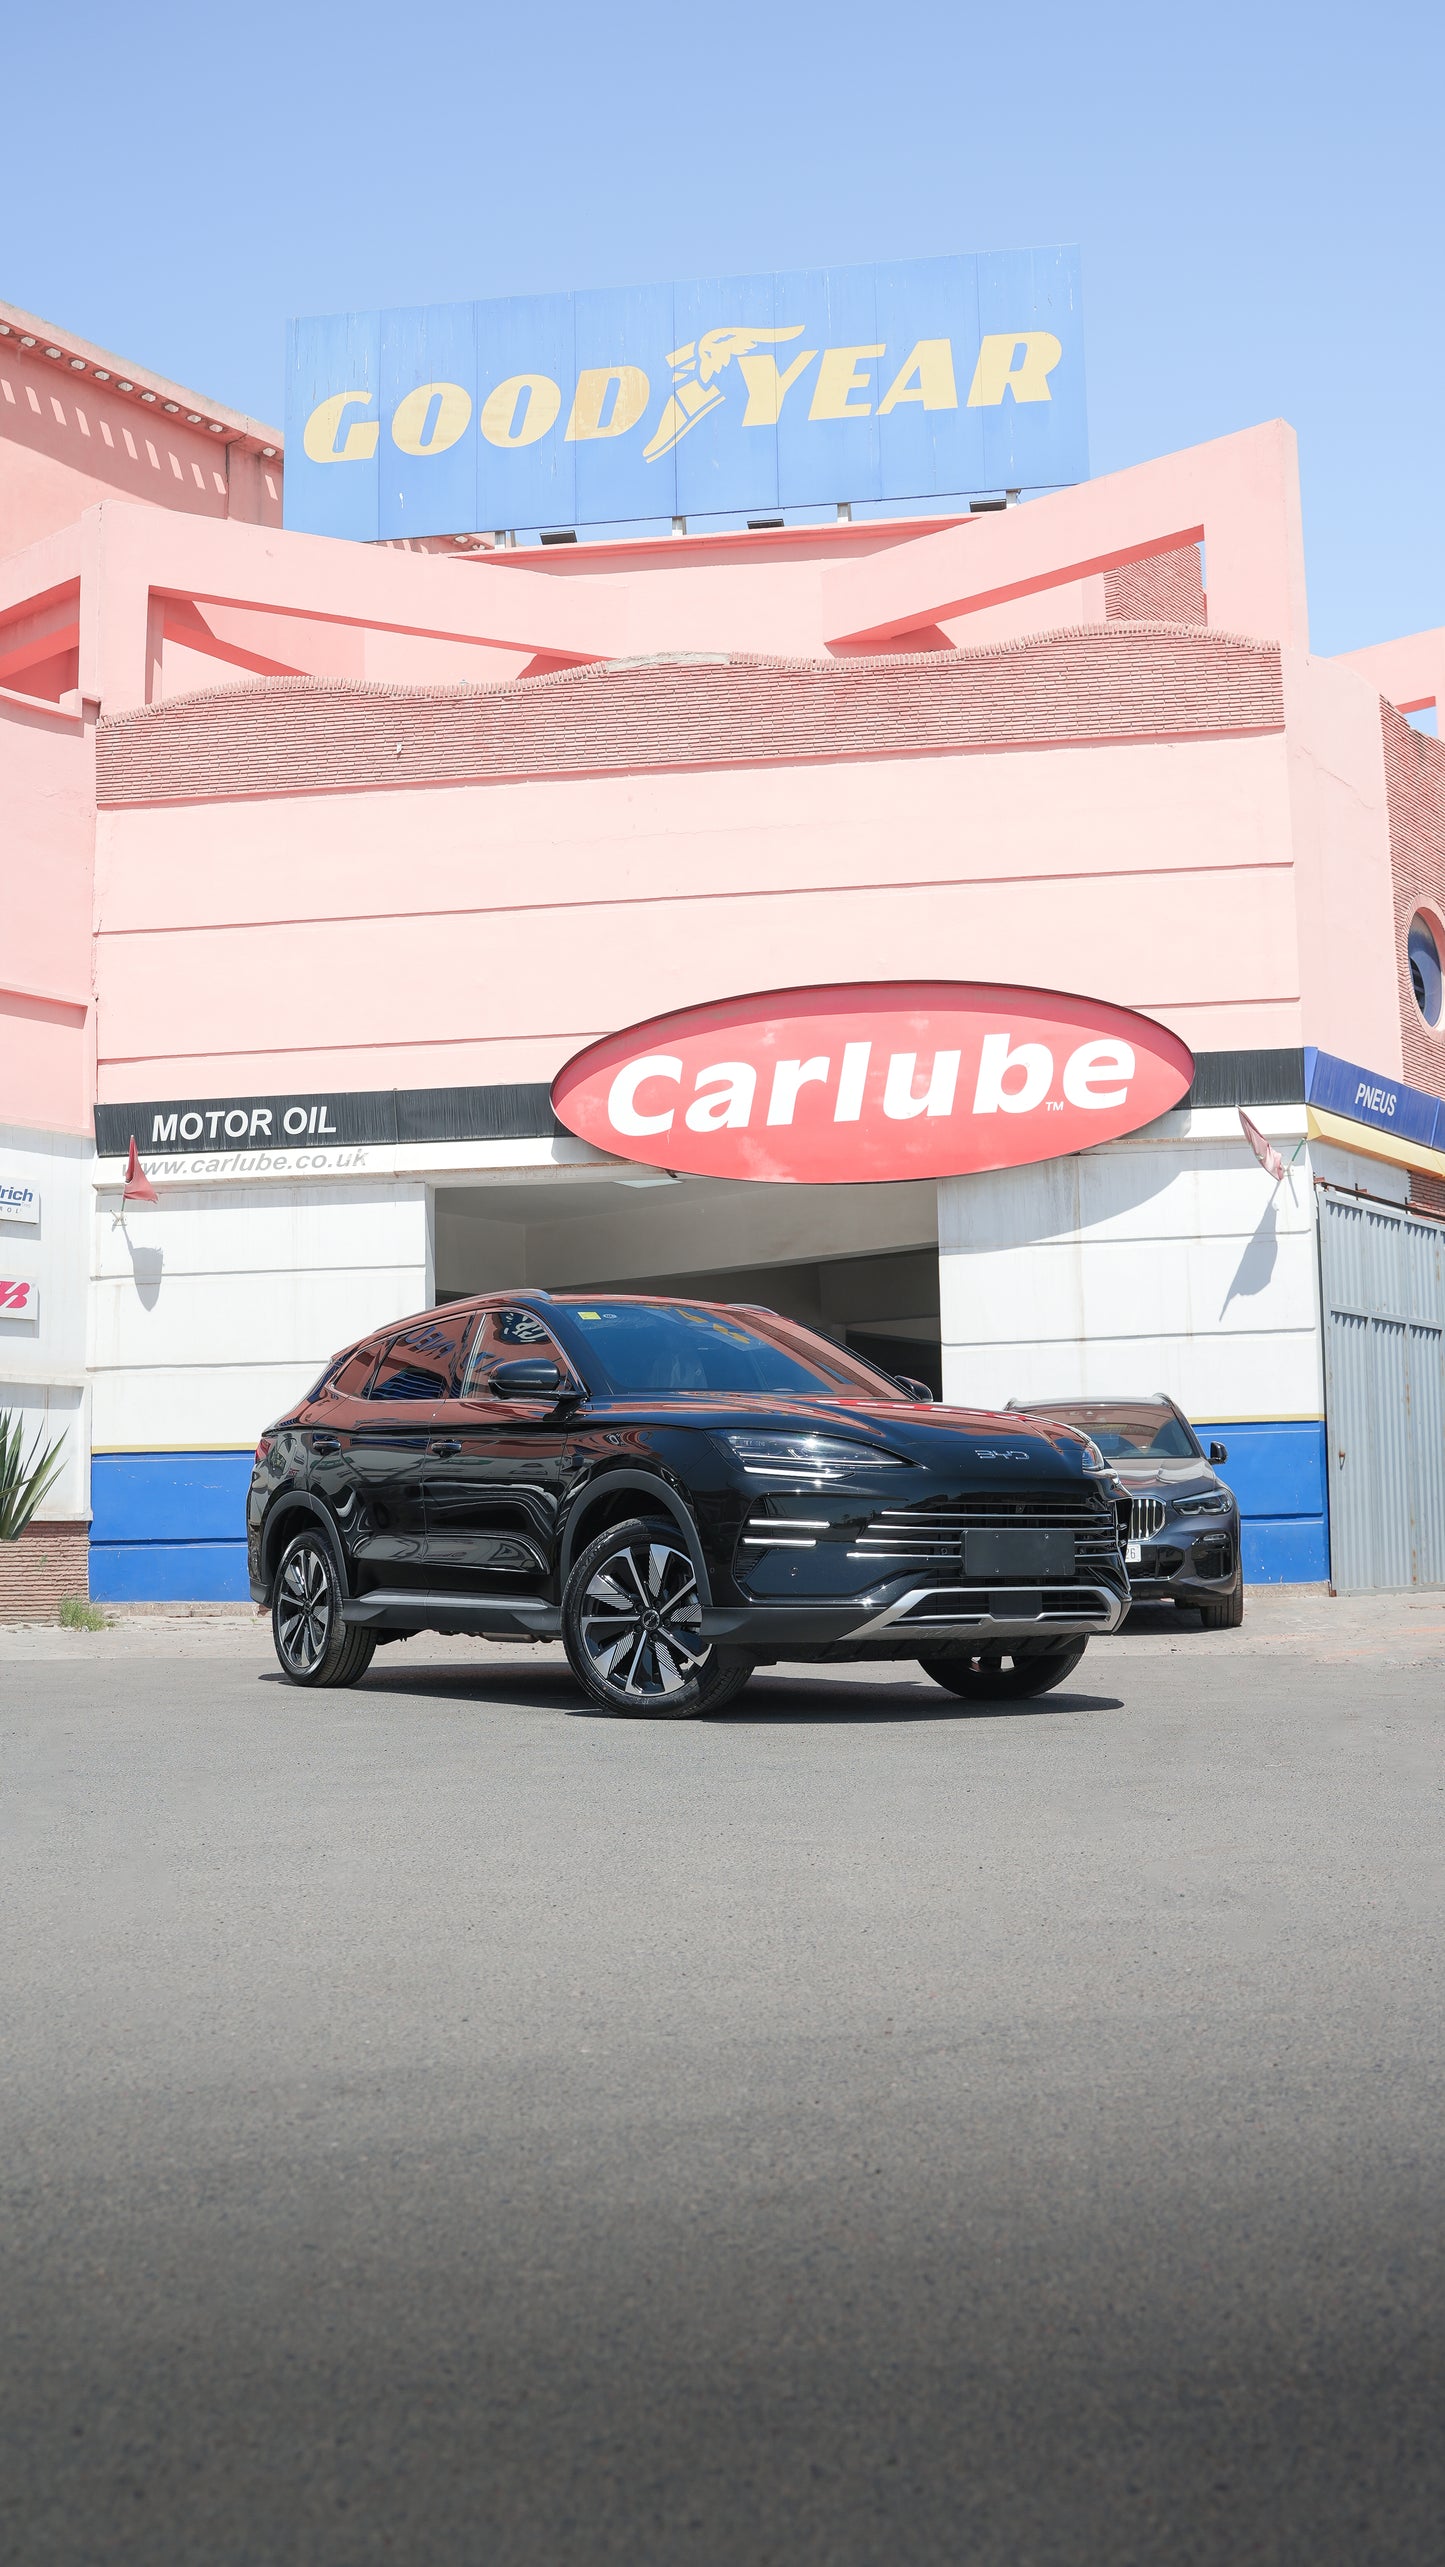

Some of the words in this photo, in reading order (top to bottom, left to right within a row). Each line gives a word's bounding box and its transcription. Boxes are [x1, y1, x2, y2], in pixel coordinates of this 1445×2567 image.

[607, 1033, 1136, 1137] Carlube
[1354, 1082, 1397, 1117] PNEUS
[1045, 1100, 1065, 1112] TM
[152, 1108, 273, 1143] MOTOR
[283, 1106, 337, 1135] OIL
[0, 1184, 34, 1202] rich
